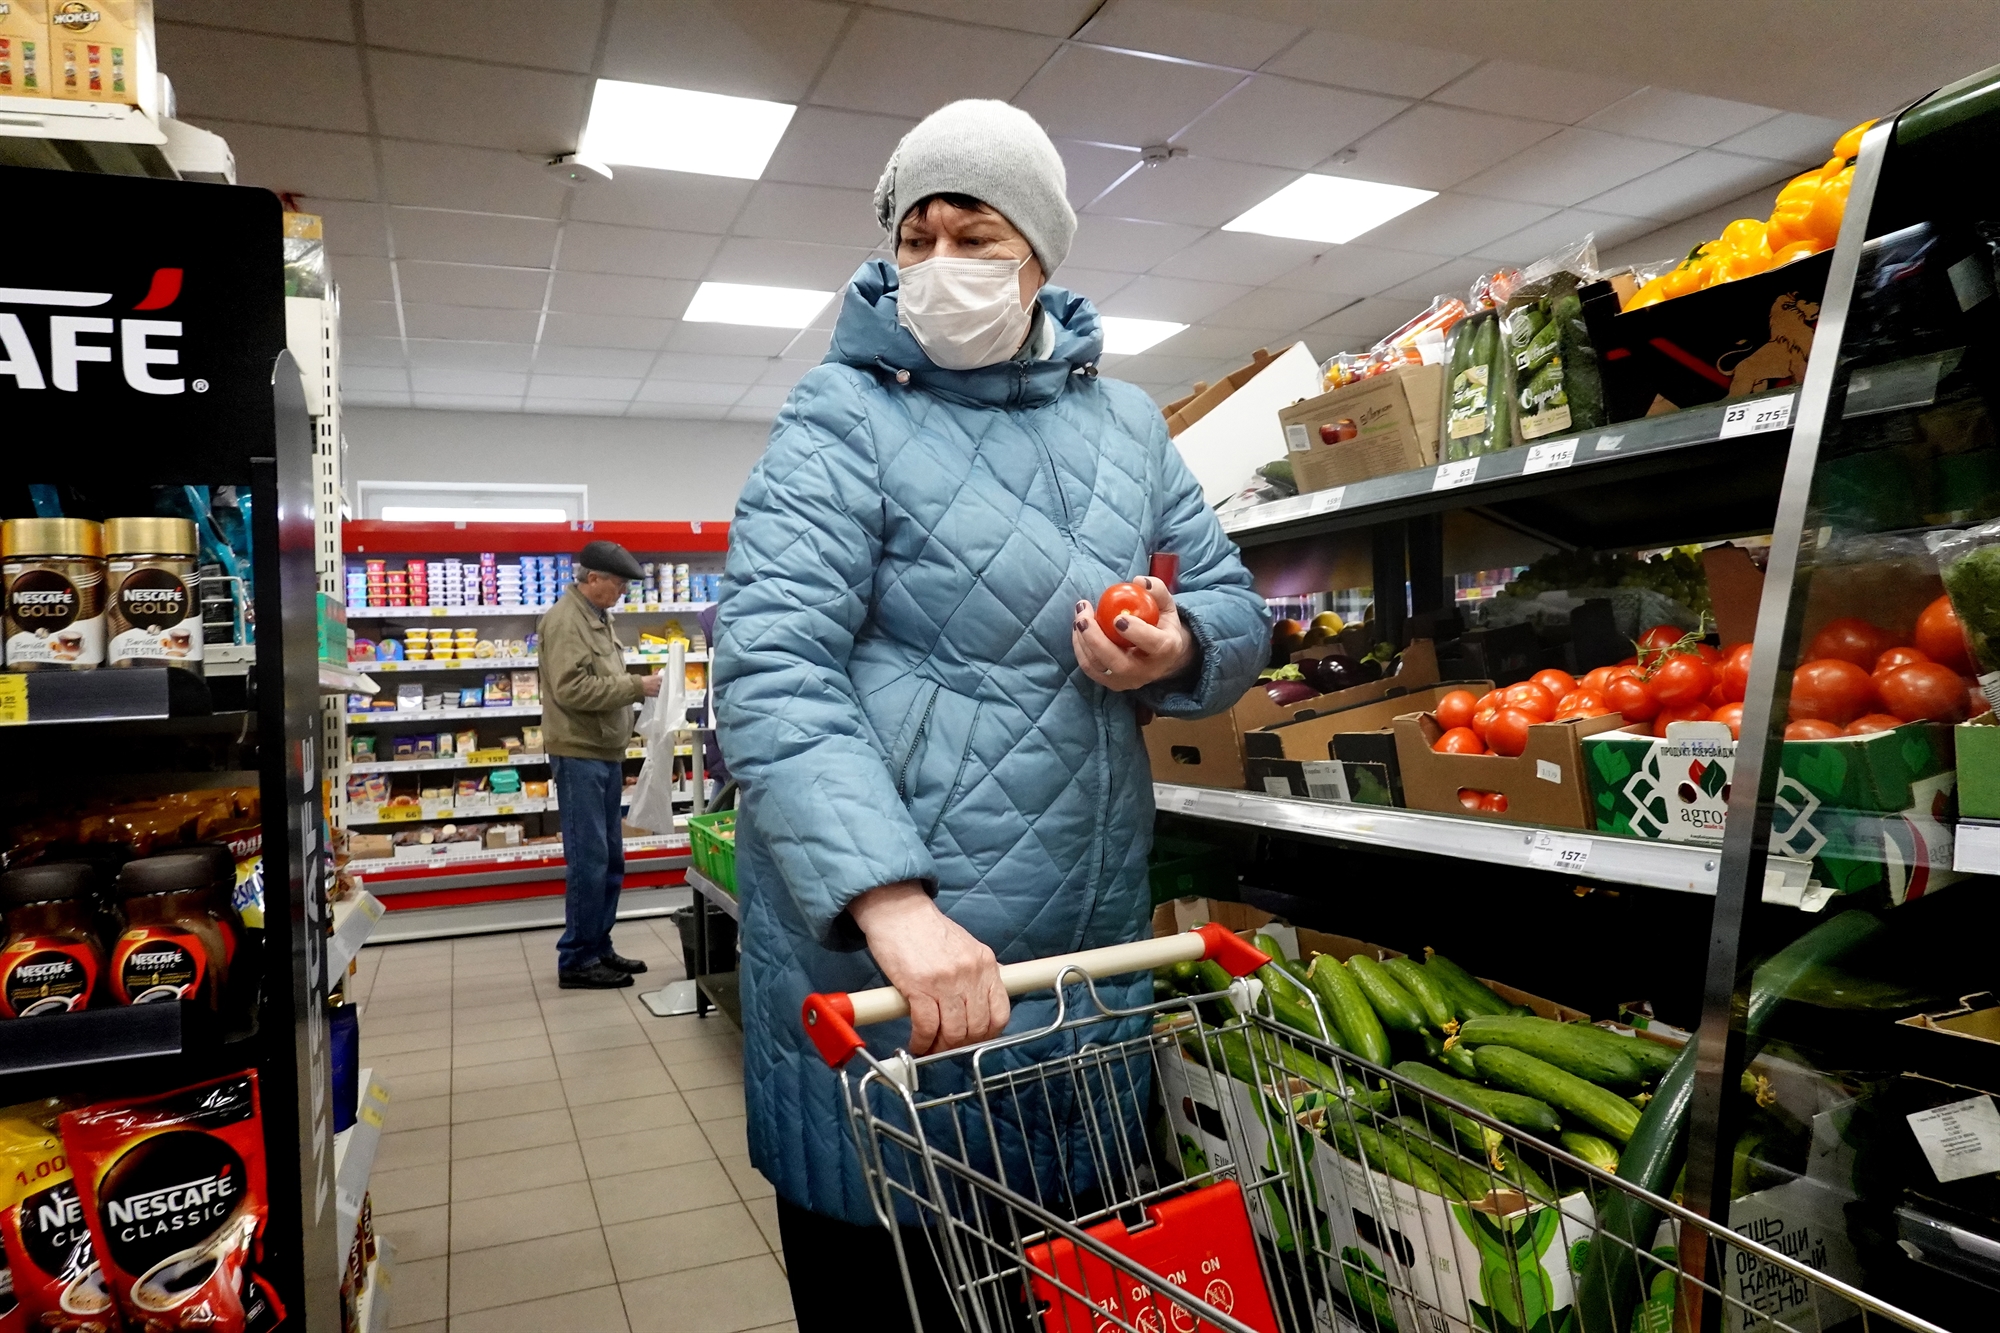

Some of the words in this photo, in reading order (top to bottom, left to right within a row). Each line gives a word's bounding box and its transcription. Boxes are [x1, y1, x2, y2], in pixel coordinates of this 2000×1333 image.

[1727, 409, 1746, 422] 23
[1756, 410, 1781, 423] 275
[1550, 451, 1568, 461] 115
[1459, 468, 1471, 477] 83
[13, 588, 73, 604] NESCAFÉ
[123, 586, 184, 602] NESCAFÉ
[18, 605, 69, 617] GOLD
[129, 602, 179, 614] GOLD
[1692, 747, 1736, 758] АЗЕРБАЙДЖ
[1681, 808, 1723, 828] agro
[1560, 850, 1581, 861] 157
[131, 949, 182, 965] NESCAFÉ
[16, 960, 74, 978] NESCAFÉ
[136, 962, 176, 971] CLASSIC
[108, 1164, 234, 1228] NESCAFÉ
[38, 1197, 82, 1233] NE
[120, 1202, 226, 1243] CLASSIC
